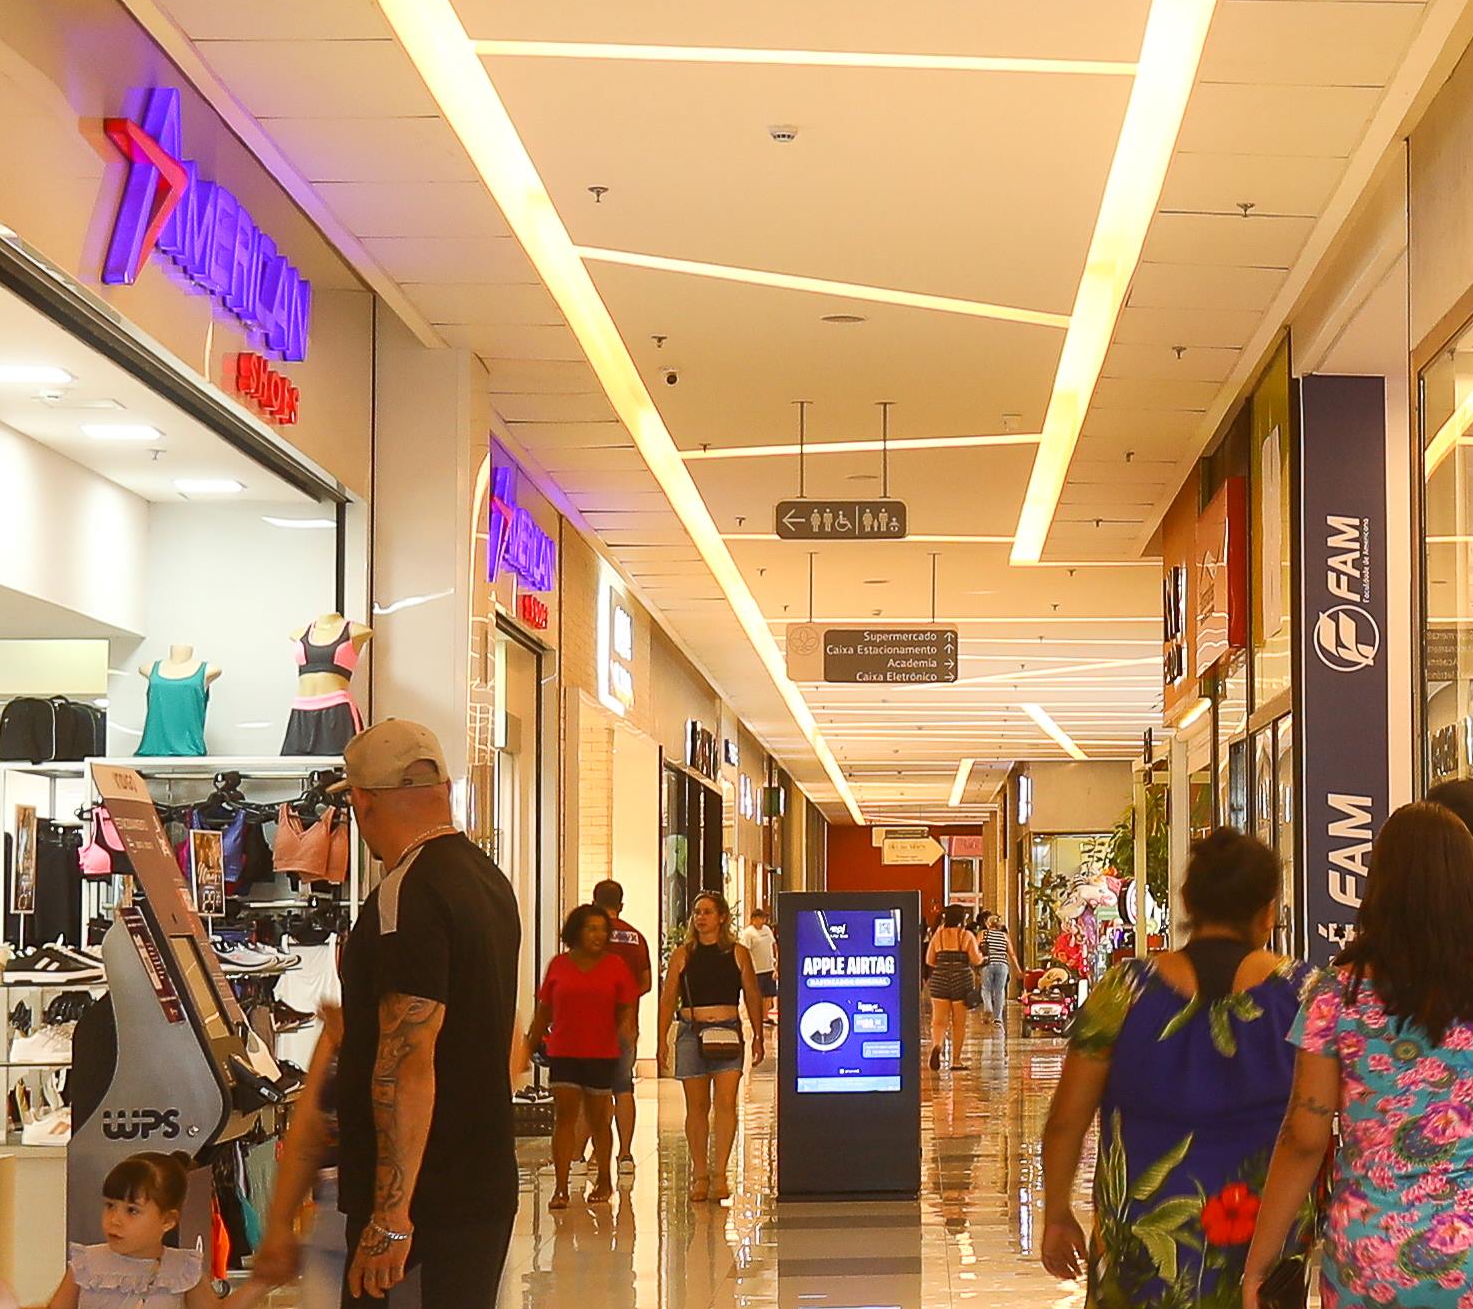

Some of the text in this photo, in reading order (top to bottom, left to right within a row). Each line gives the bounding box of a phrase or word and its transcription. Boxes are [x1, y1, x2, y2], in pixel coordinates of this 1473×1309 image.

[1326, 515, 1361, 603] FAM
[863, 631, 937, 643] Supermercado
[827, 645, 937, 655] Caixa Estacionamento
[887, 658, 937, 668] Academia
[856, 671, 884, 682] Caixa
[1327, 793, 1373, 909] FAM
[803, 955, 895, 976] APPLE AIRTAG
[102, 1109, 181, 1141] WPS
